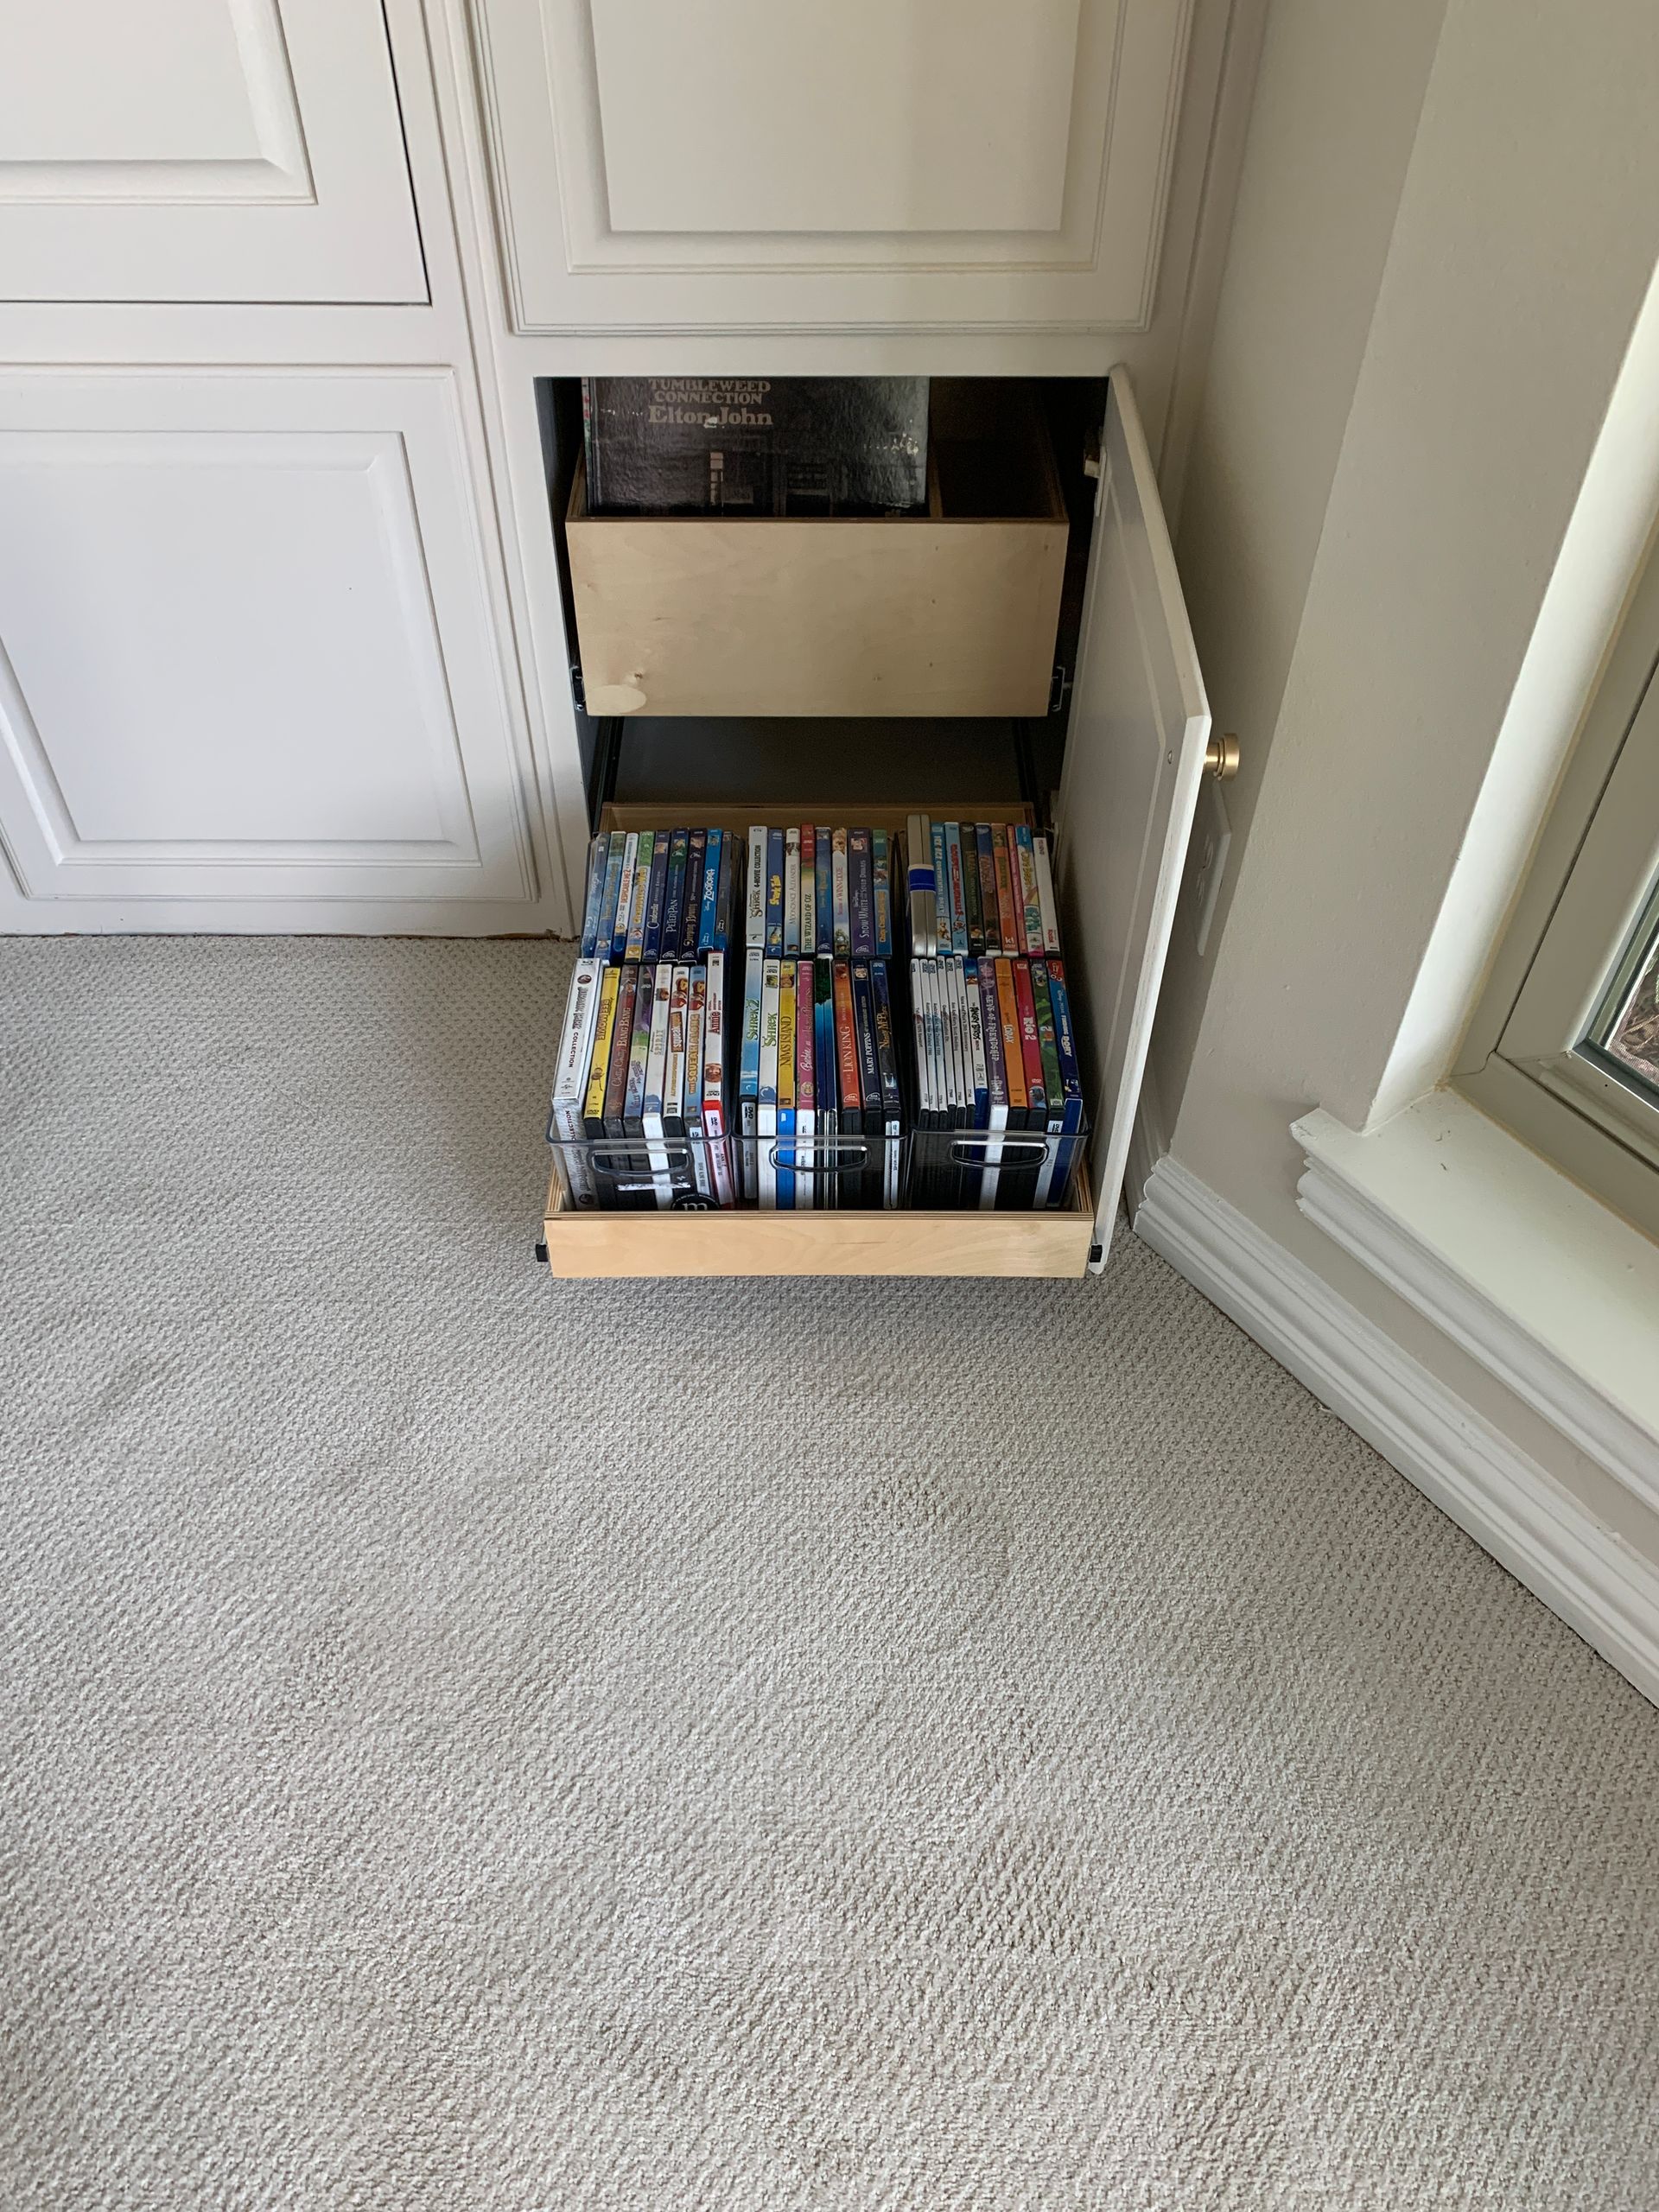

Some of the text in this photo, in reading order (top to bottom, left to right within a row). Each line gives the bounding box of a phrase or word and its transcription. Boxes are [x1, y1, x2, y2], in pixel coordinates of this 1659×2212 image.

[648, 379, 771, 392] TUMBLEWEED
[655, 391, 762, 404] CONNECTION
[648, 405, 773, 425] Elton John
[704, 868, 715, 901] ZOOTOPIA
[596, 999, 609, 1040] BEE MOVIE
[620, 1007, 631, 1027] BANG
[709, 1012, 721, 1034] Annie
[746, 999, 760, 1040] SHREK 2
[969, 1007, 980, 1023] ANGRY
[1023, 1017, 1033, 1034] Rio
[617, 1027, 629, 1047] BANG
[761, 1013, 777, 1047] SHREK
[780, 1016, 791, 1044] ISLAND
[840, 1026, 852, 1052] KING
[972, 1024, 982, 1040] BIRDS
[569, 1032, 579, 1067] COLLECTION
[653, 1029, 664, 1056] SPIRIT
[864, 1032, 873, 1056] POPPINS
[986, 1022, 999, 1062] FRIENDSHIP
[1060, 1035, 1072, 1057] DORY
[843, 1053, 854, 1072] LION
[867, 1056, 875, 1074] MARY
[565, 1110, 575, 1141] OLLECTION
